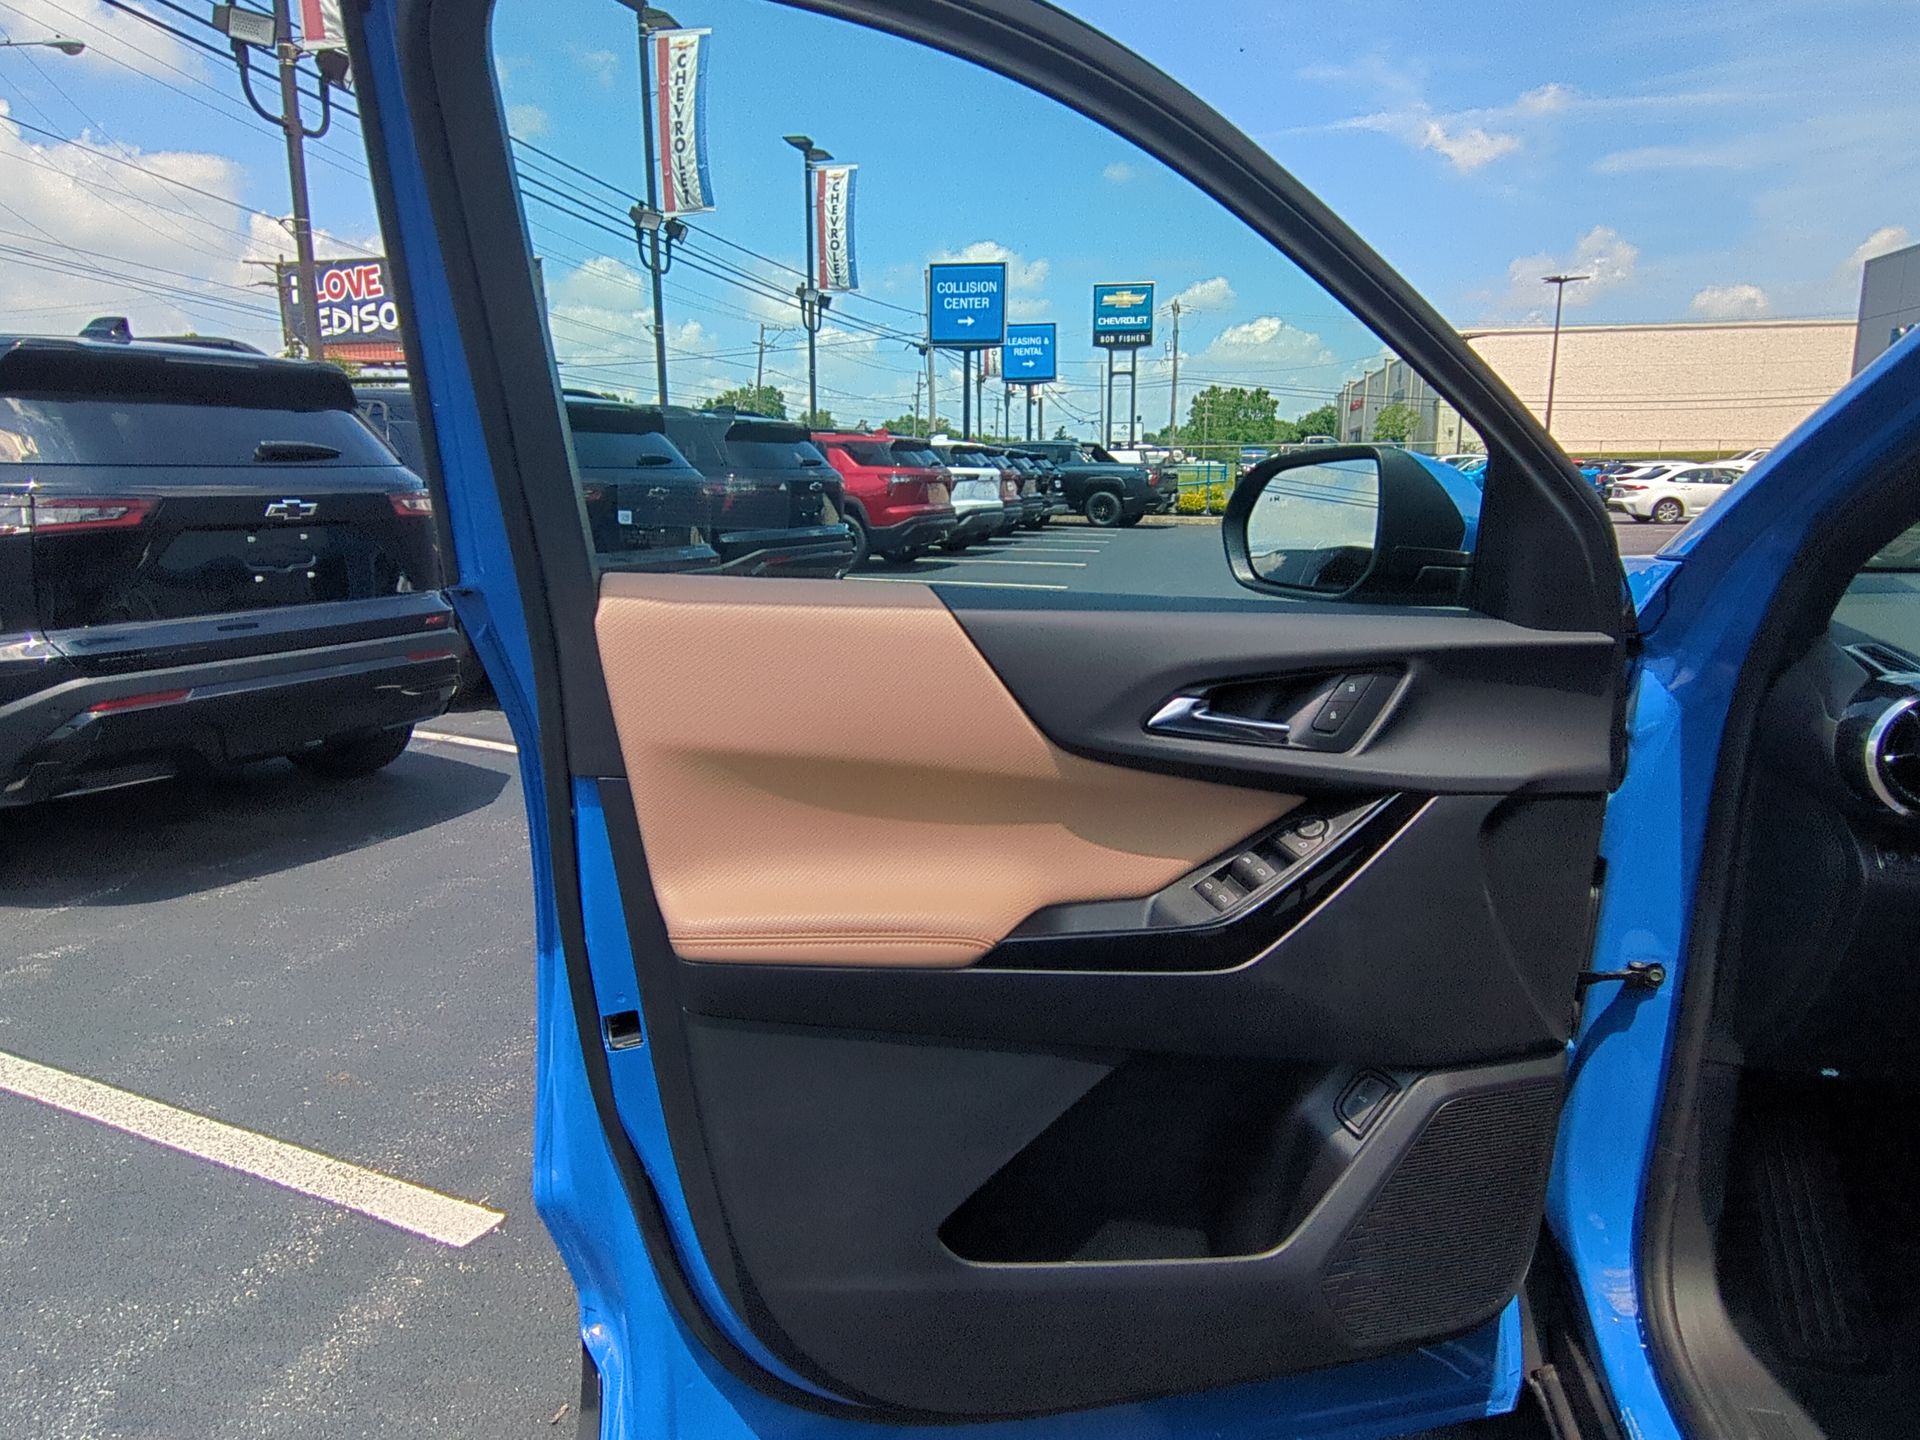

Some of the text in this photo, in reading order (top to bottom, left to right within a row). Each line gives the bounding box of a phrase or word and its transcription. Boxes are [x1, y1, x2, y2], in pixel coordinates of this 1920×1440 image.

[673, 53, 690, 204] CHEVROLET
[830, 182, 842, 286] CHEVROLET
[937, 281, 997, 294] COLLISION
[944, 297, 990, 310] CENTER
[1098, 316, 1148, 325] CHEVROLET
[1007, 336, 1042, 346] LEASING
[1100, 334, 1145, 343] BOB FISHER
[1013, 347, 1043, 356] RENTAL
